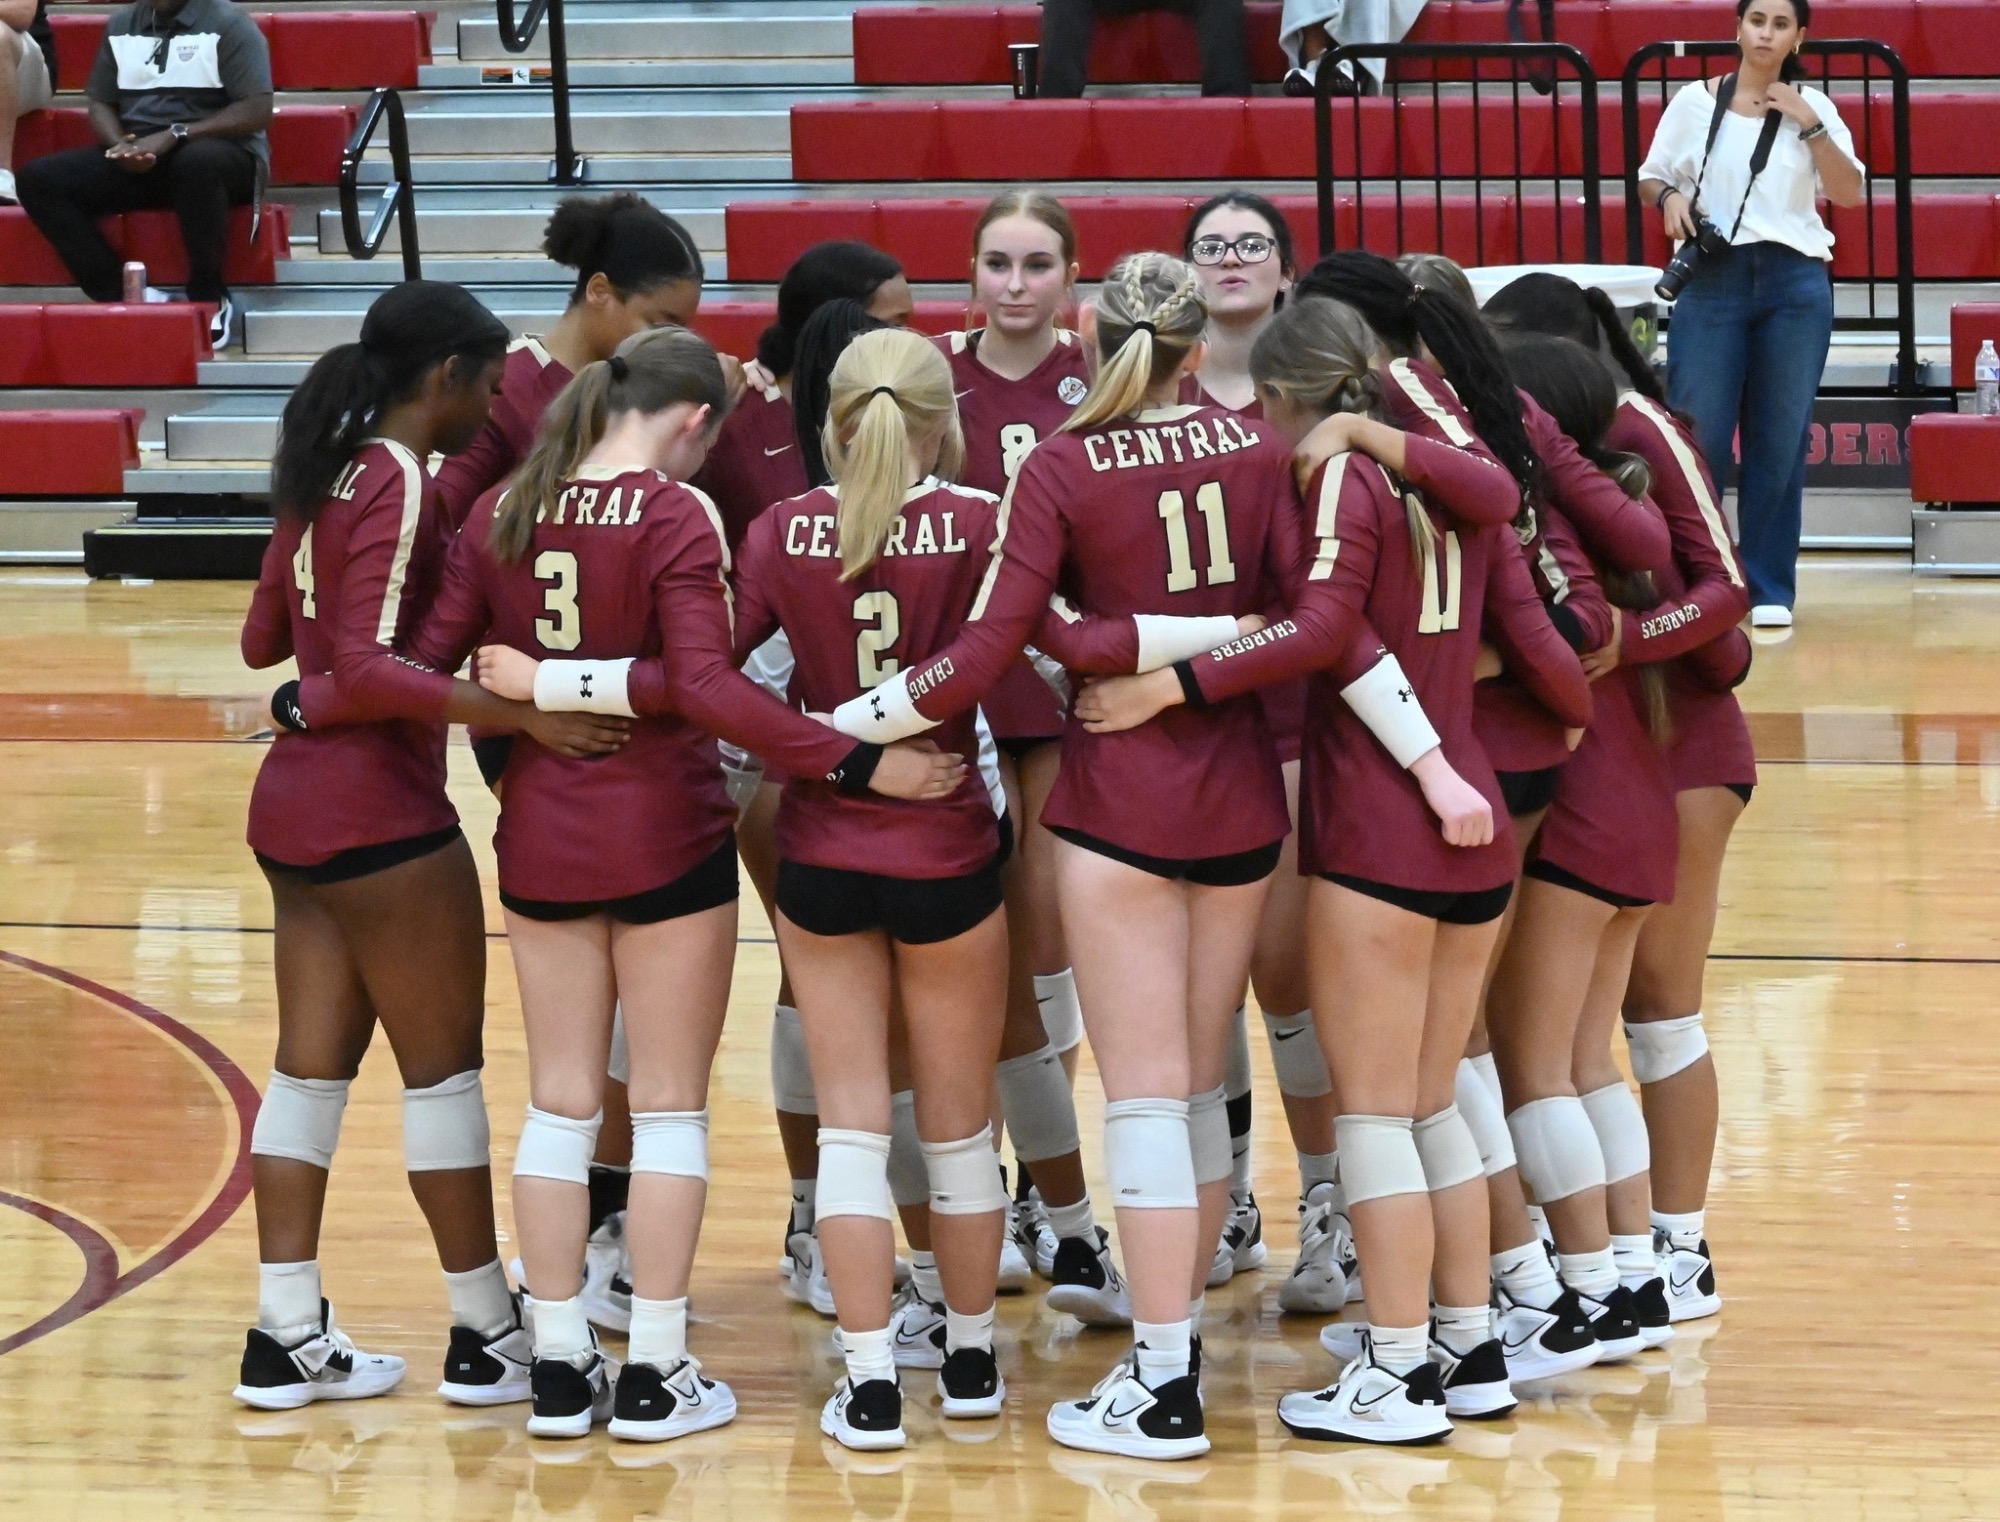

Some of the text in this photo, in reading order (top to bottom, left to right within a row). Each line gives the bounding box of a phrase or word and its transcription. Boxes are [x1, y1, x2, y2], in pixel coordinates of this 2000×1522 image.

[1083, 417, 1261, 472] CENTRAL
[785, 511, 967, 559] CERAL
[1157, 481, 1236, 593] 11
[292, 520, 317, 620] 4
[533, 550, 582, 652] 3
[1642, 603, 1701, 640] CHARGERS
[852, 590, 900, 688] 2
[1210, 619, 1298, 662] CHARGERS
[905, 656, 955, 704] CHARG
